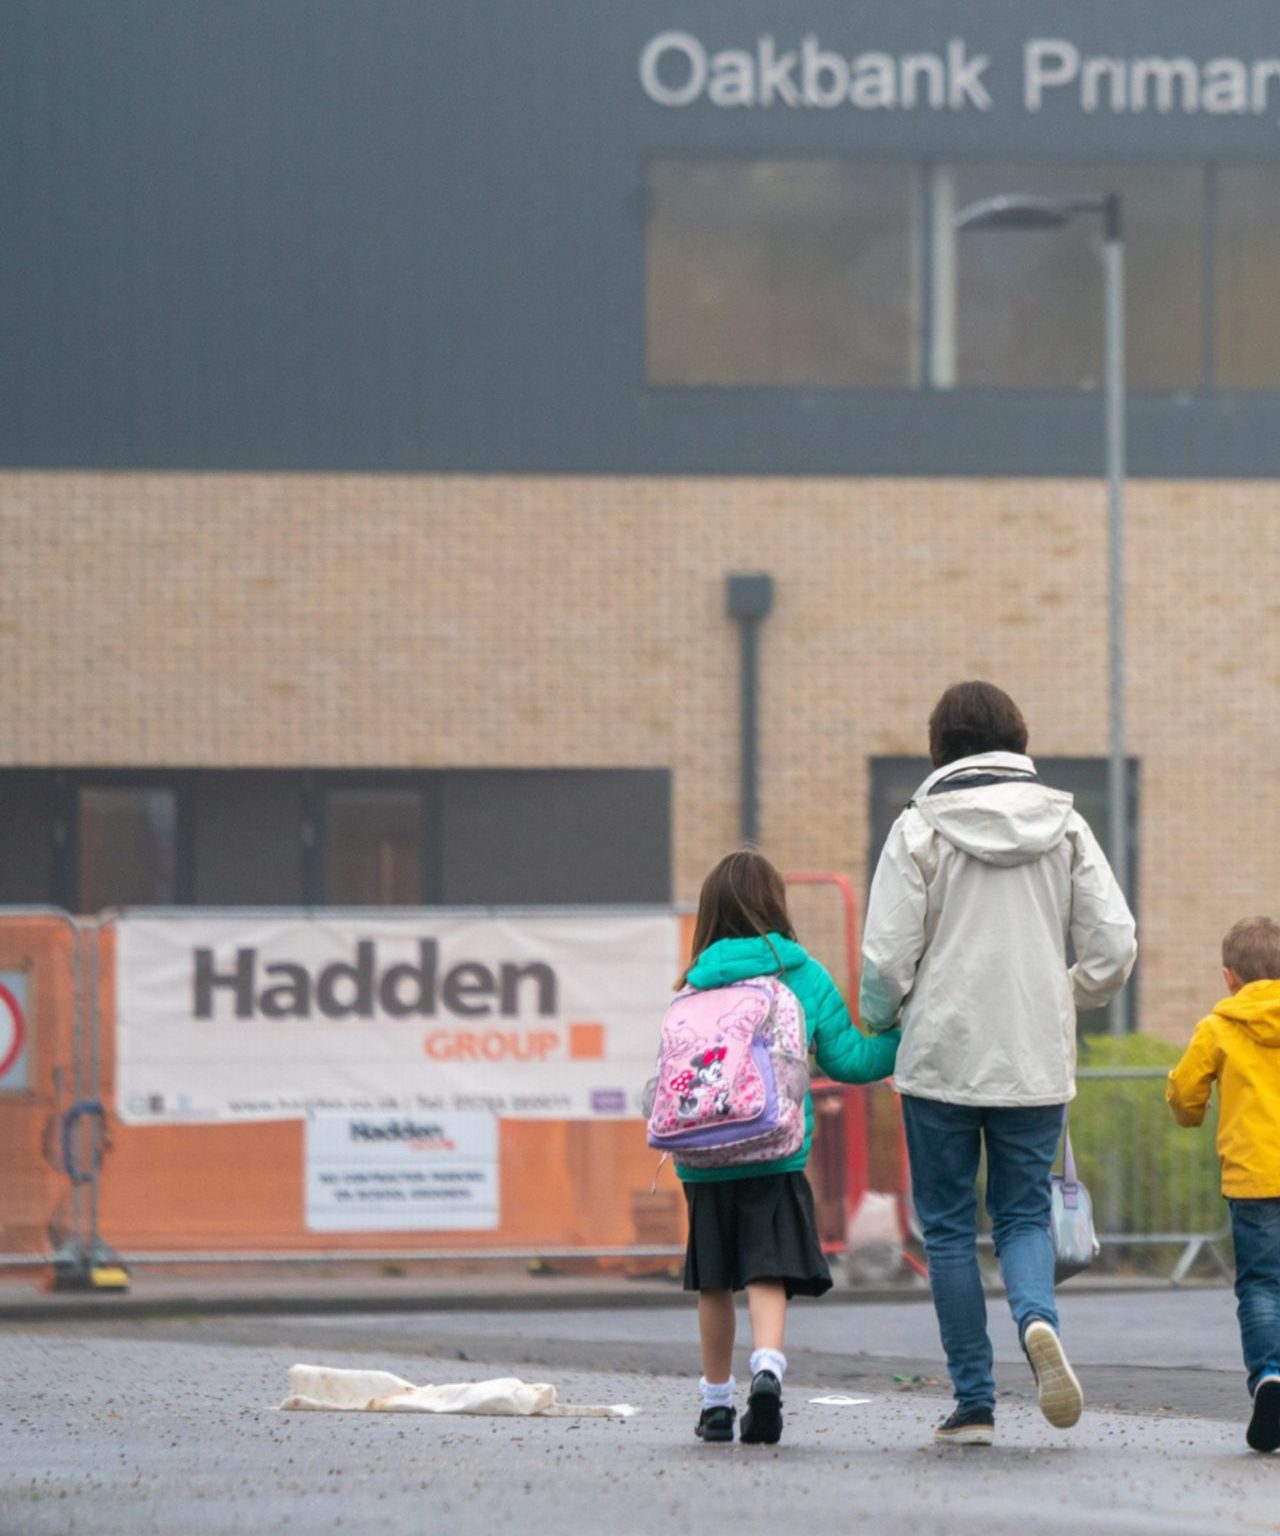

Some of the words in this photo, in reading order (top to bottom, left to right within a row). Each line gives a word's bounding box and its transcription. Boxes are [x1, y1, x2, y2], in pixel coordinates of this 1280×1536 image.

[640, 30, 993, 111] Oakbank
[193, 938, 558, 1020] Hadden
[424, 1029, 560, 1061] GROUP
[351, 1121, 443, 1142] Hadden
